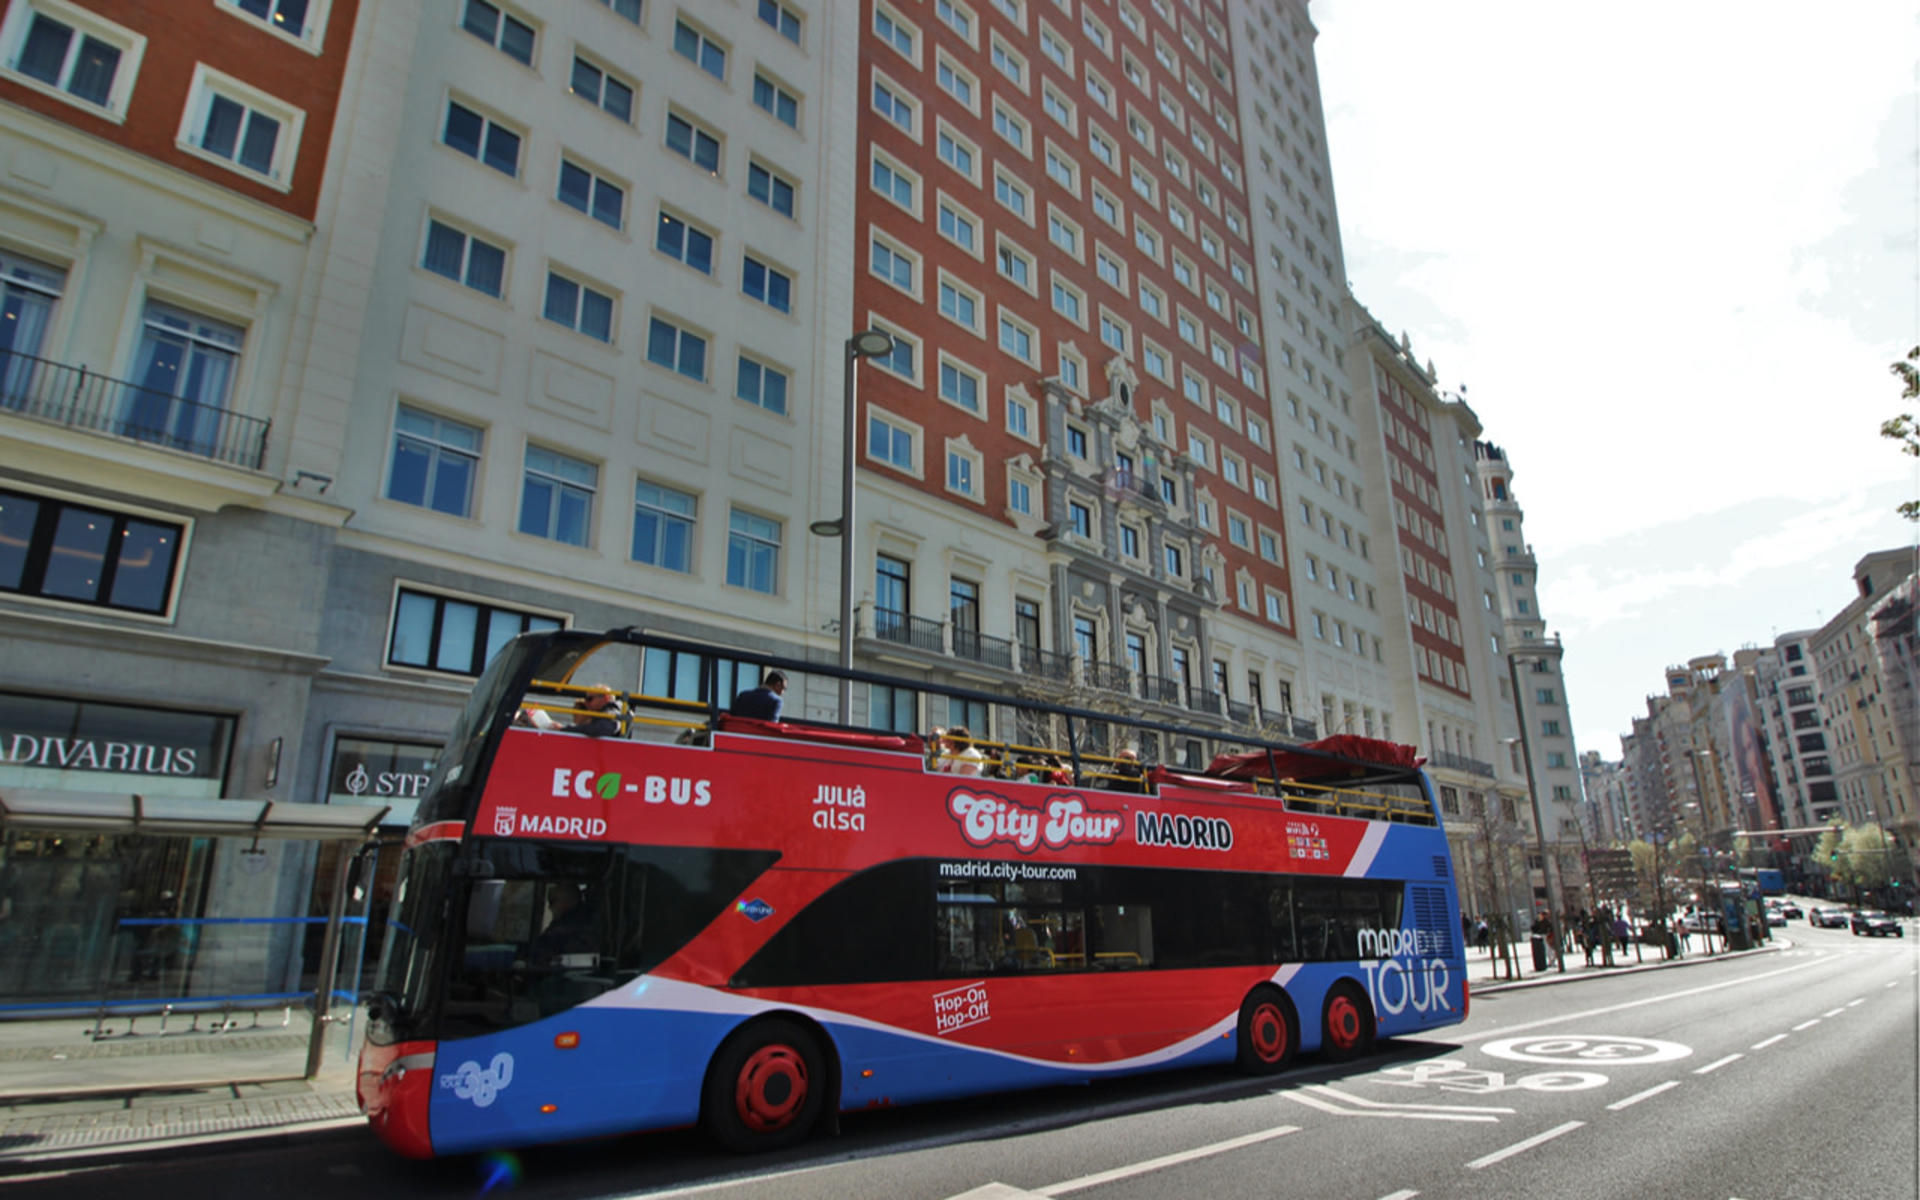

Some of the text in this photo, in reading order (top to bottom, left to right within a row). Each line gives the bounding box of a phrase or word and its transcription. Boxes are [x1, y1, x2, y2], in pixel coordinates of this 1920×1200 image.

[0, 733, 197, 775] DIVARIUS
[520, 814, 607, 839] MADRID
[812, 807, 866, 832] alsa
[953, 793, 1233, 851] City Tour MADRID
[939, 861, 1077, 882] madrid.city-tour.com
[934, 988, 986, 1014] Hop-On
[1359, 958, 1451, 1017] TOUR
[936, 1000, 989, 1030] Hop-Off
